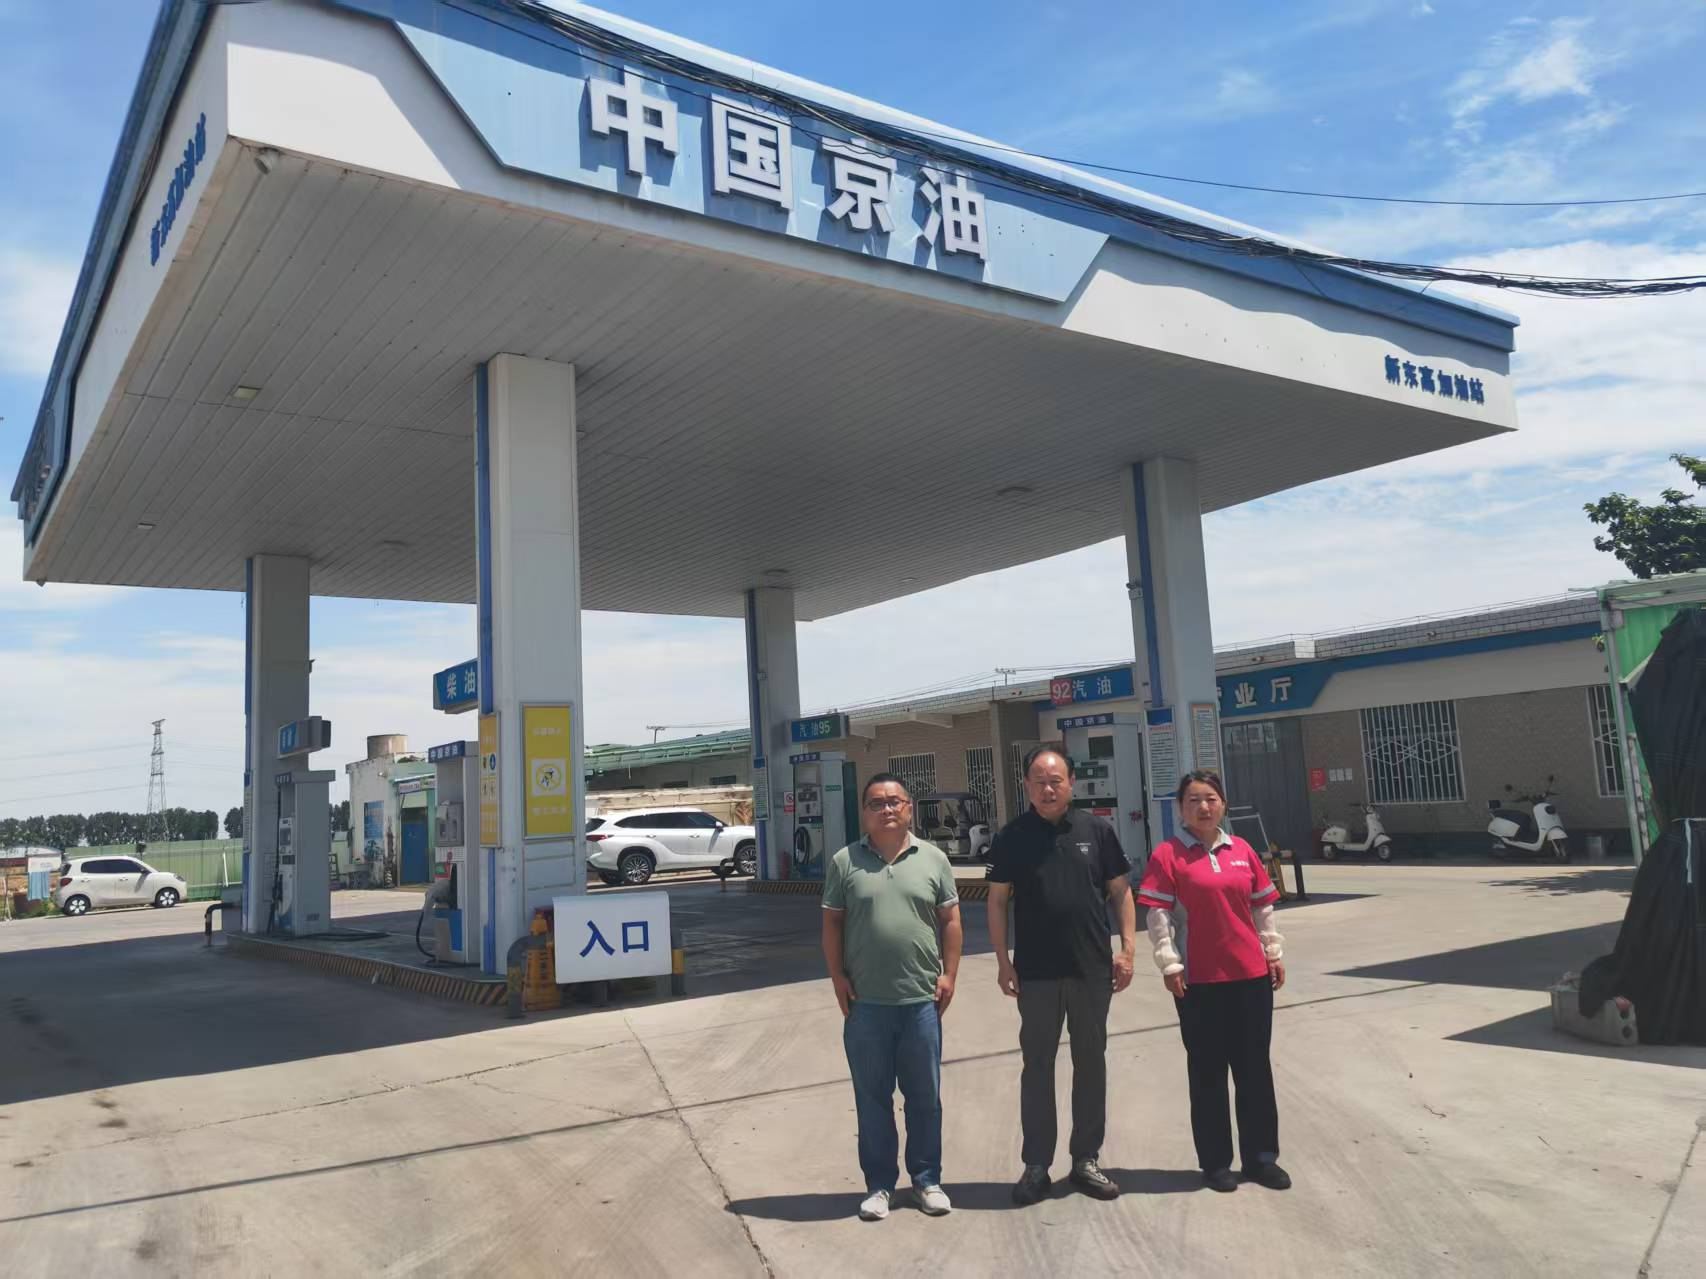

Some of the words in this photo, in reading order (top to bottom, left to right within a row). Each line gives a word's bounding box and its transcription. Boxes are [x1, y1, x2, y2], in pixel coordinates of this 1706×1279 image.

[590, 65, 988, 261] 中国京油
[447, 667, 476, 700] 柴油
[1216, 676, 1293, 711] 业厅
[579, 919, 650, 958] 入口
